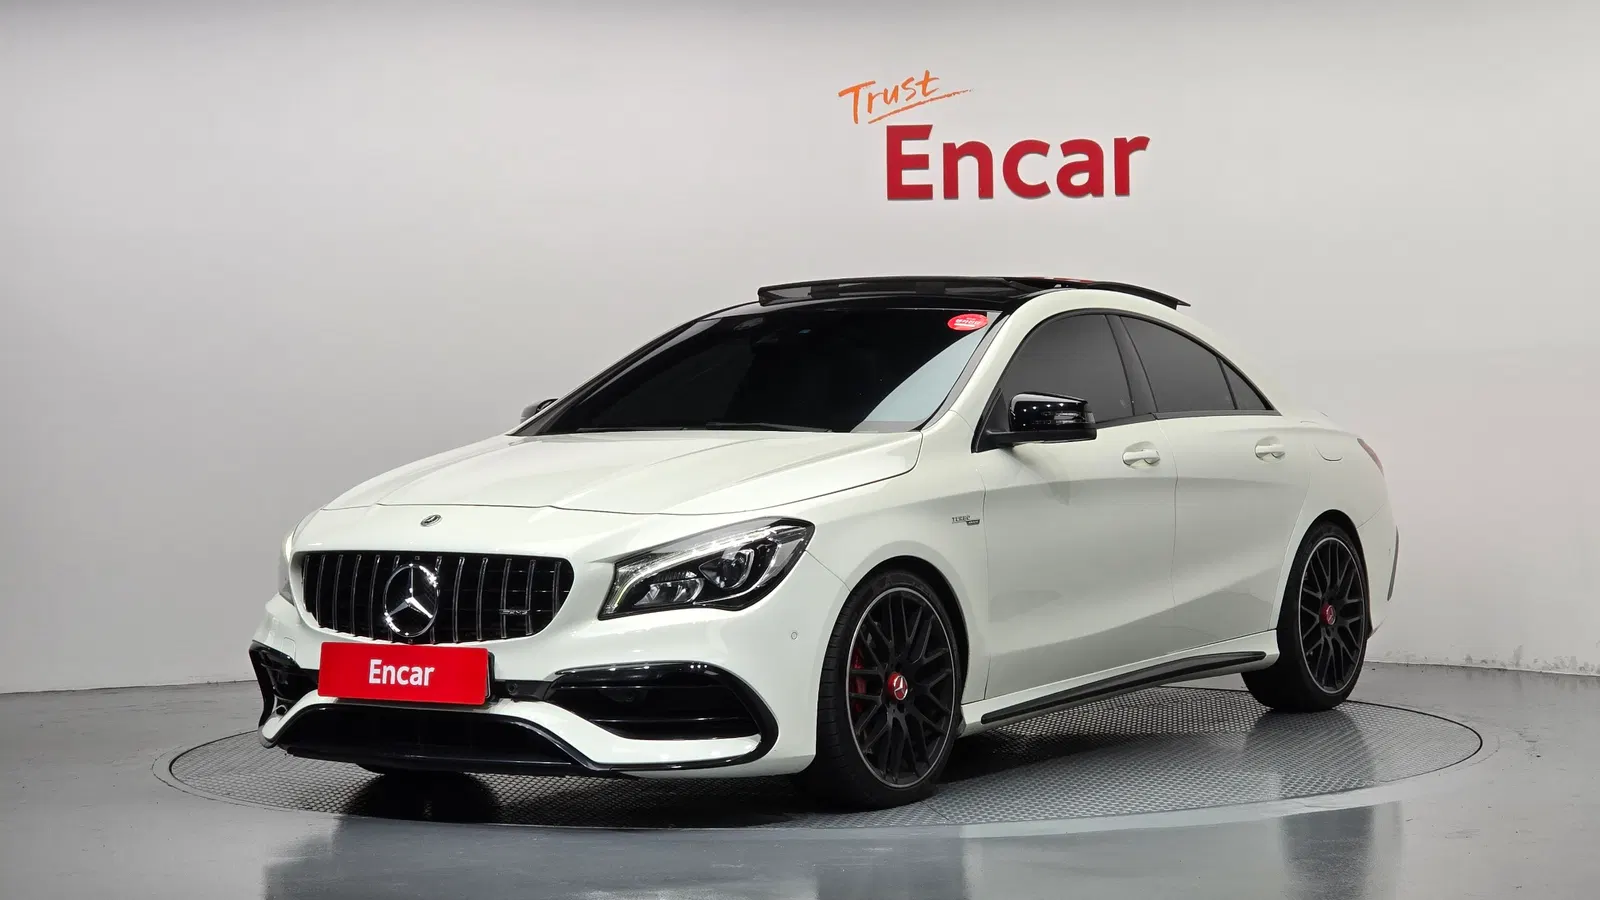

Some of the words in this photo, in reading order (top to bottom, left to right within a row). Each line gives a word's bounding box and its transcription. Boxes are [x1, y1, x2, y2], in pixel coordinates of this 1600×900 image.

[838, 70, 940, 124] Trust
[886, 124, 1150, 200] Encar
[368, 659, 435, 686] Encar
